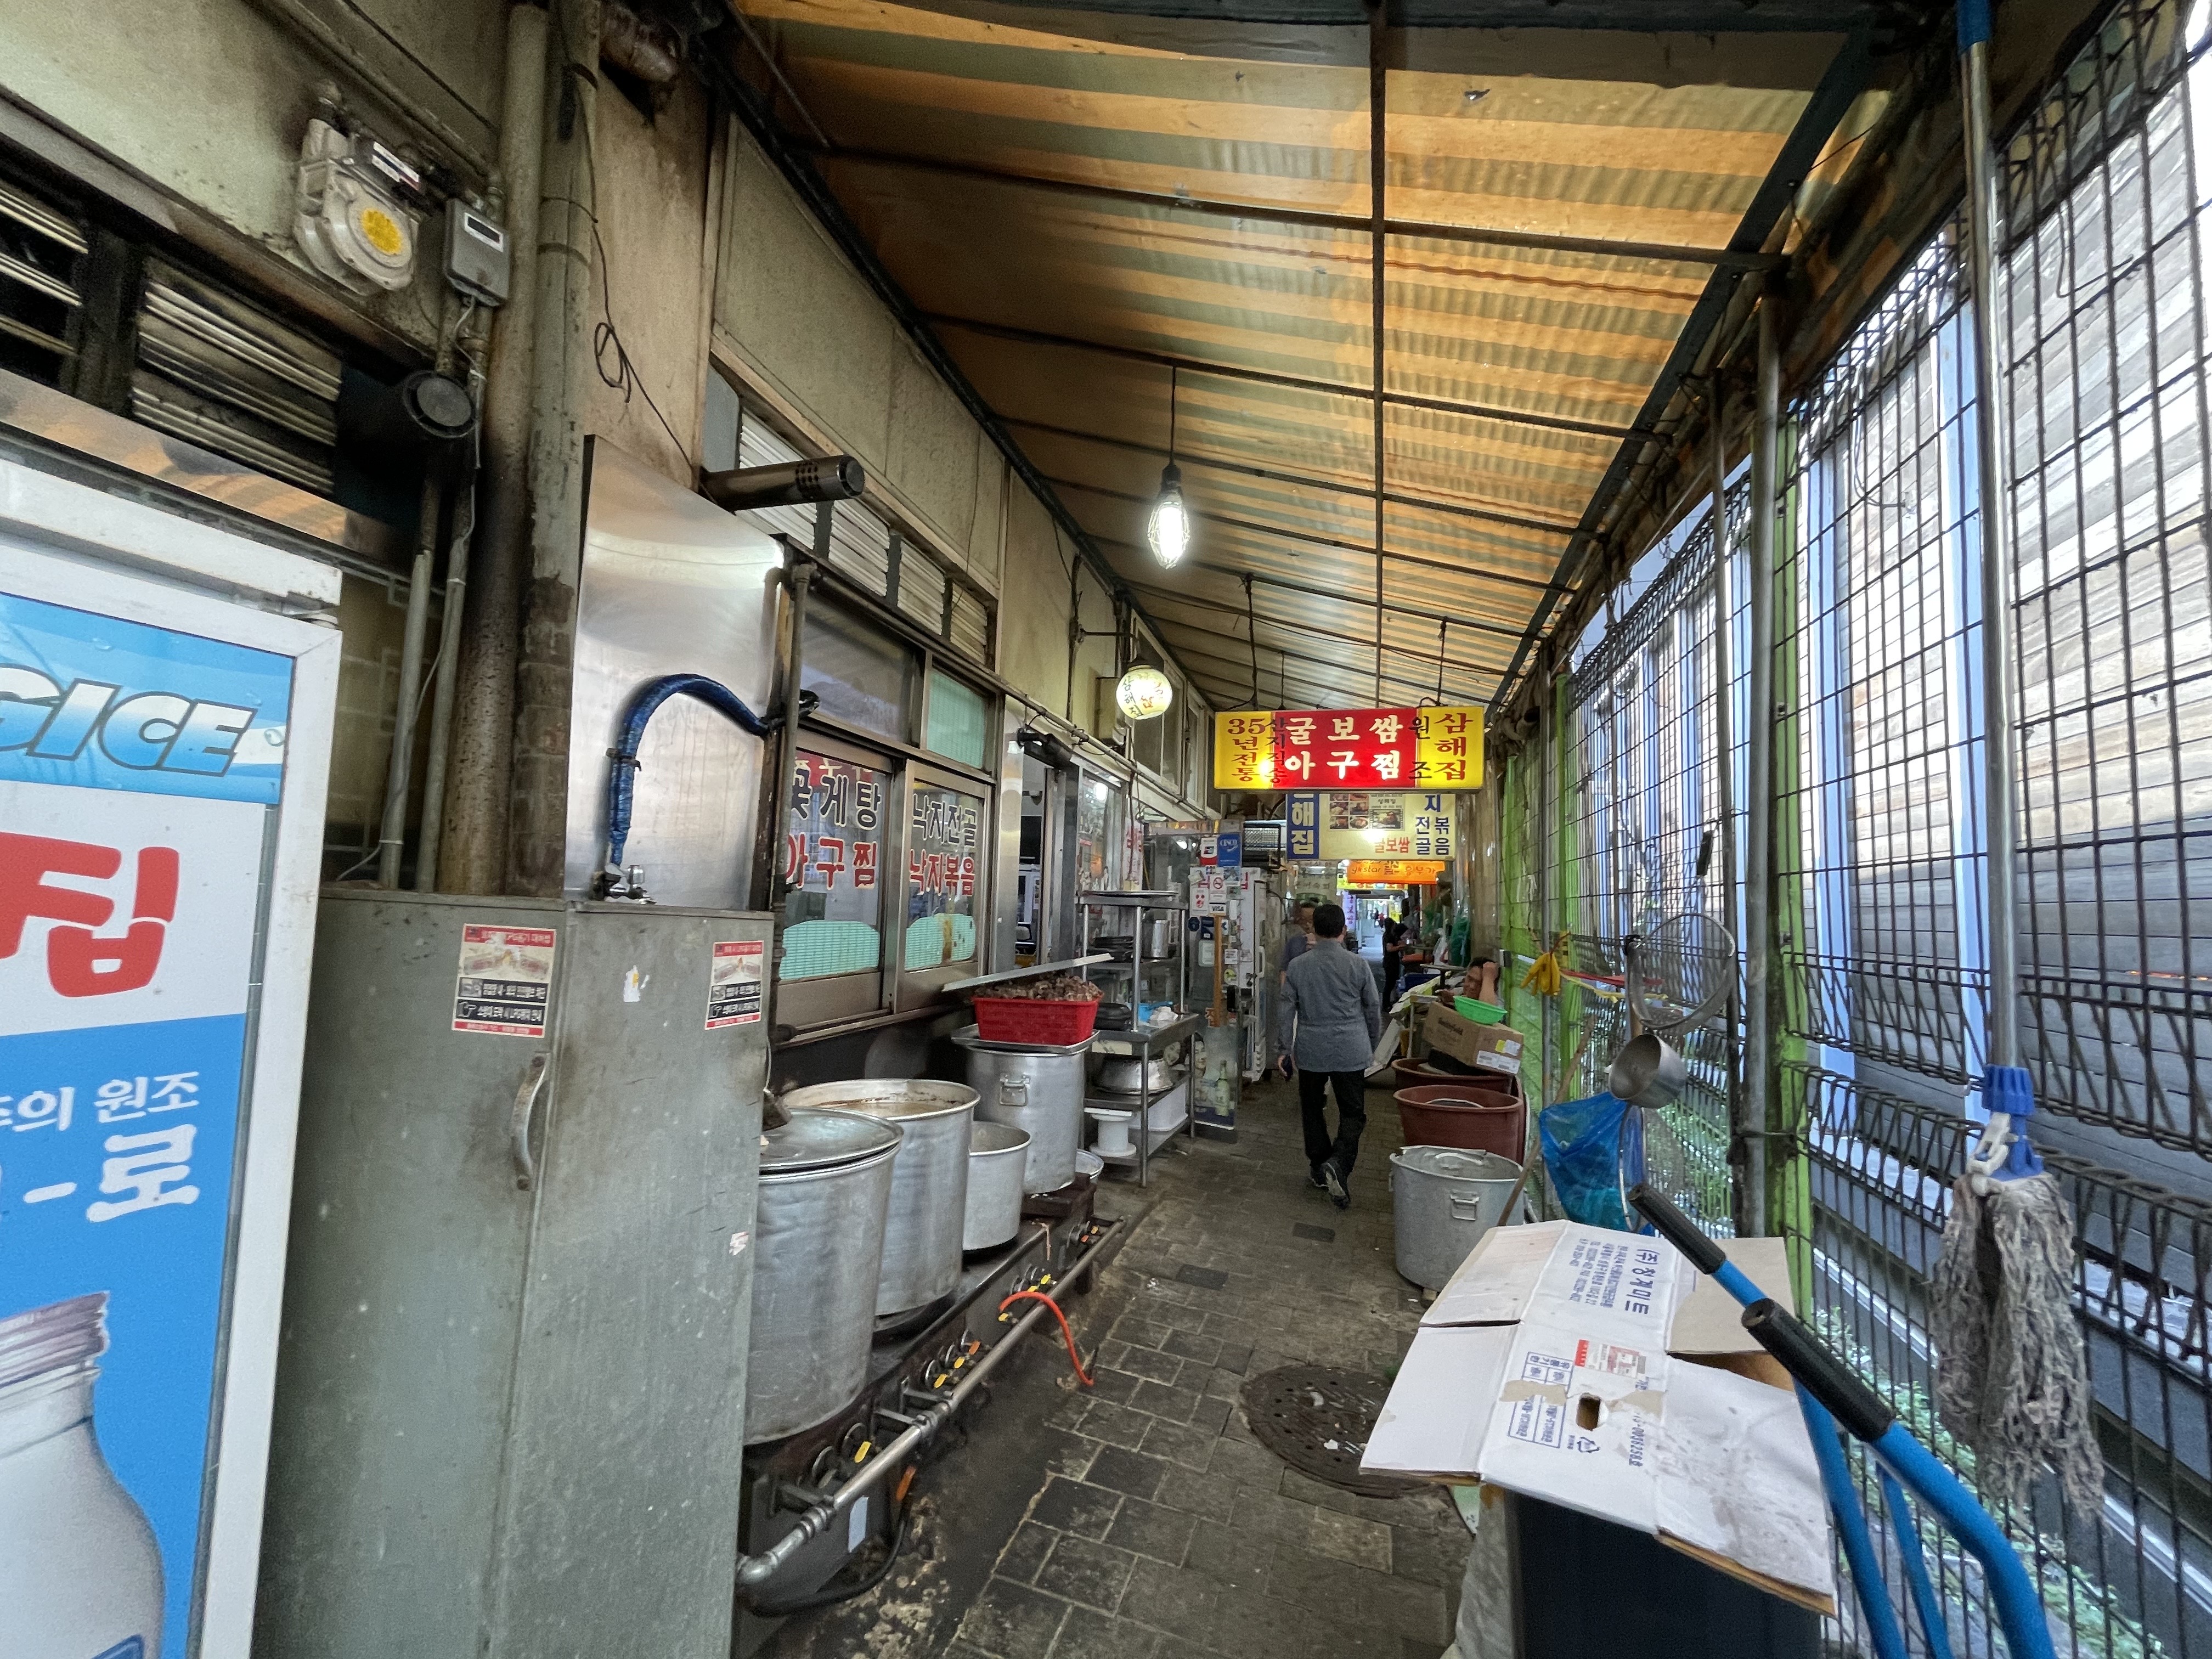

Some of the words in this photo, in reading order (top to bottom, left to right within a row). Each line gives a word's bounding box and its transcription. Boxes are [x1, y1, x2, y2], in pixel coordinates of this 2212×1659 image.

[1285, 714, 1404, 745] 굴보쌈
[1434, 713, 1474, 781] 삼해집
[1284, 751, 1401, 781] 아구찜
[912, 793, 978, 848] 낙지전골
[1291, 794, 1314, 855] 해집
[1415, 816, 1431, 855] 전골
[1434, 816, 1450, 855] 볶음
[909, 849, 975, 896] 낙지볶음
[93, 1071, 200, 1123] 원조
